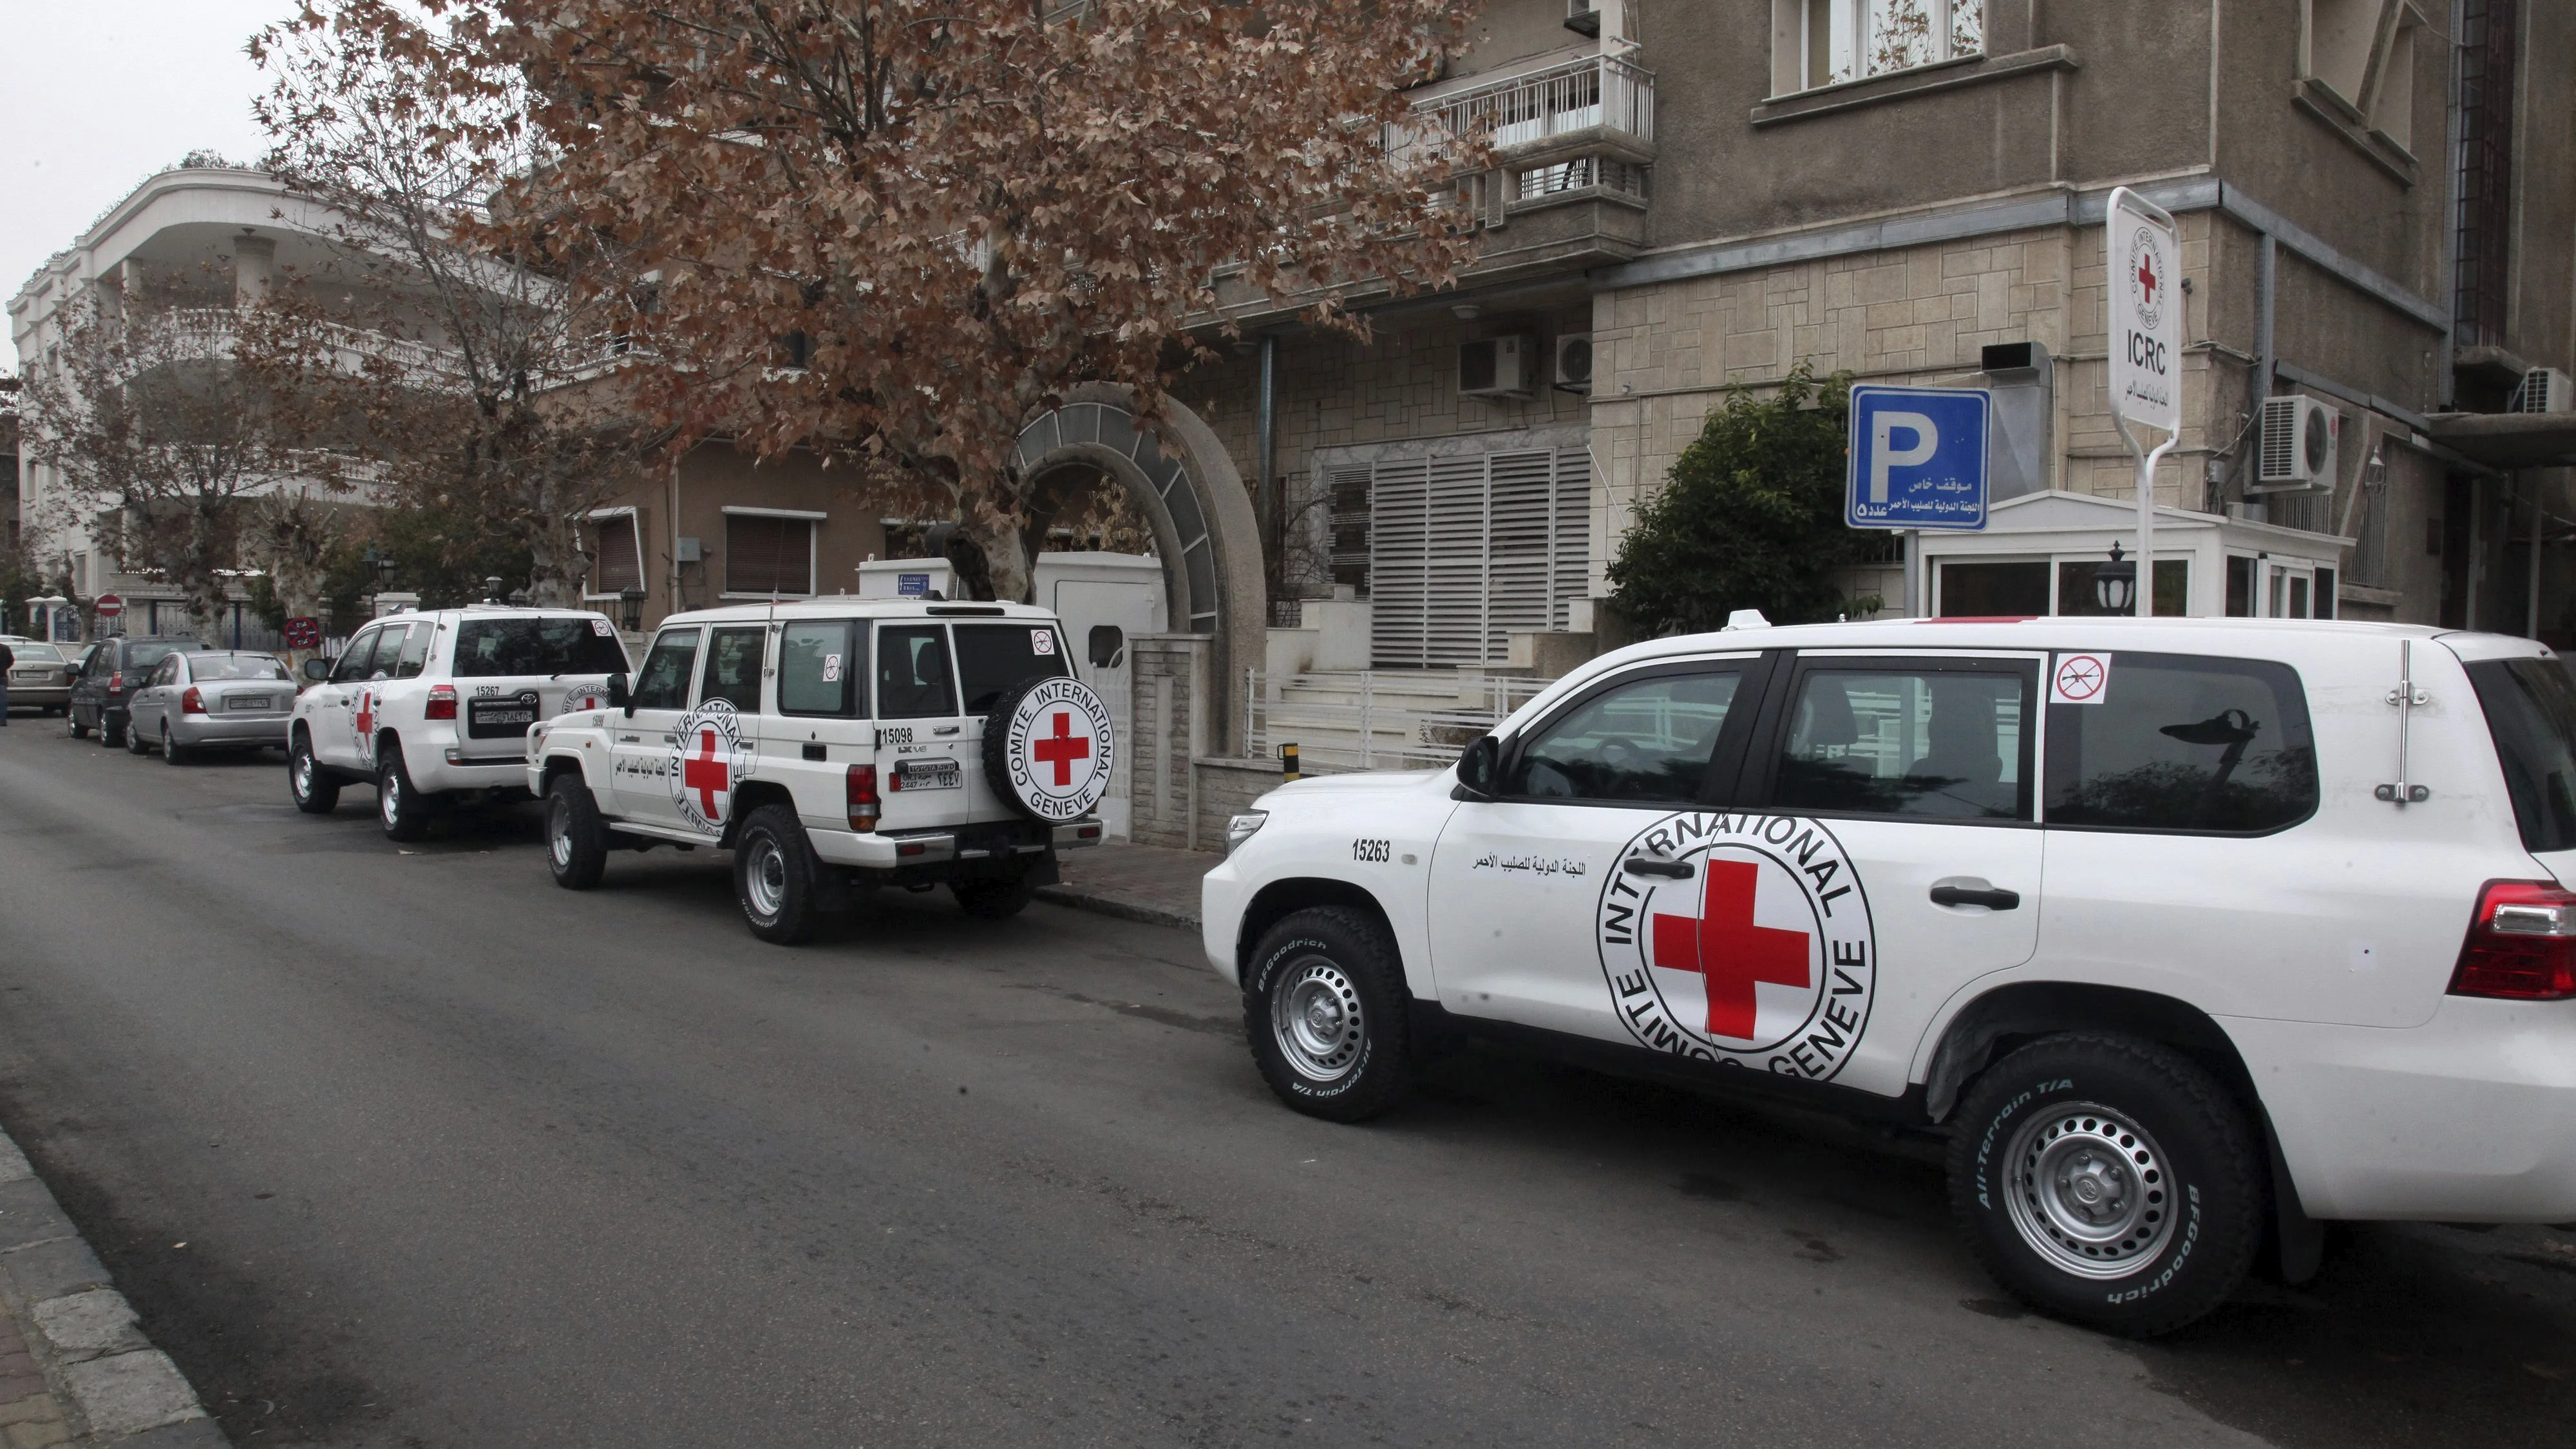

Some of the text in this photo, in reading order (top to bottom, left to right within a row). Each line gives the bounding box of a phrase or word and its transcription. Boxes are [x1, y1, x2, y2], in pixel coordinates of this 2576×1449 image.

[2130, 231, 2163, 305] COMITE INTERNATIONAL
[2137, 303, 2157, 326] GENEVE
[2128, 329, 2165, 375] ICRC
[1870, 411, 1938, 503] P
[1908, 477, 1972, 493] موقف خاص
[1857, 503, 1887, 516] عدد ٥
[1888, 497, 1980, 514] اللجنة الدولية للصليب الأحمر
[476, 686, 500, 696] 15267
[564, 695, 575, 714] MITE
[882, 728, 913, 744] 15098
[1010, 683, 1112, 786] COMITE INTERNATIONAL
[937, 772, 960, 786] ٢٤٤٧
[1030, 788, 1094, 816] GENEVE
[1352, 838, 1390, 862] 15263
[1472, 851, 1586, 878] اللجنة الدولية للصليب الأحمر
[1605, 813, 1852, 945] INTRNATIONAL
[1258, 938, 1327, 992] BFGoodrich
[1768, 940, 1866, 1077] GENEVE
[1292, 1037, 1372, 1099] All-Terrain T/A
[1977, 1079, 2074, 1210] All-Terrain T/A
[2107, 1184, 2201, 1304] BFGoodrich
